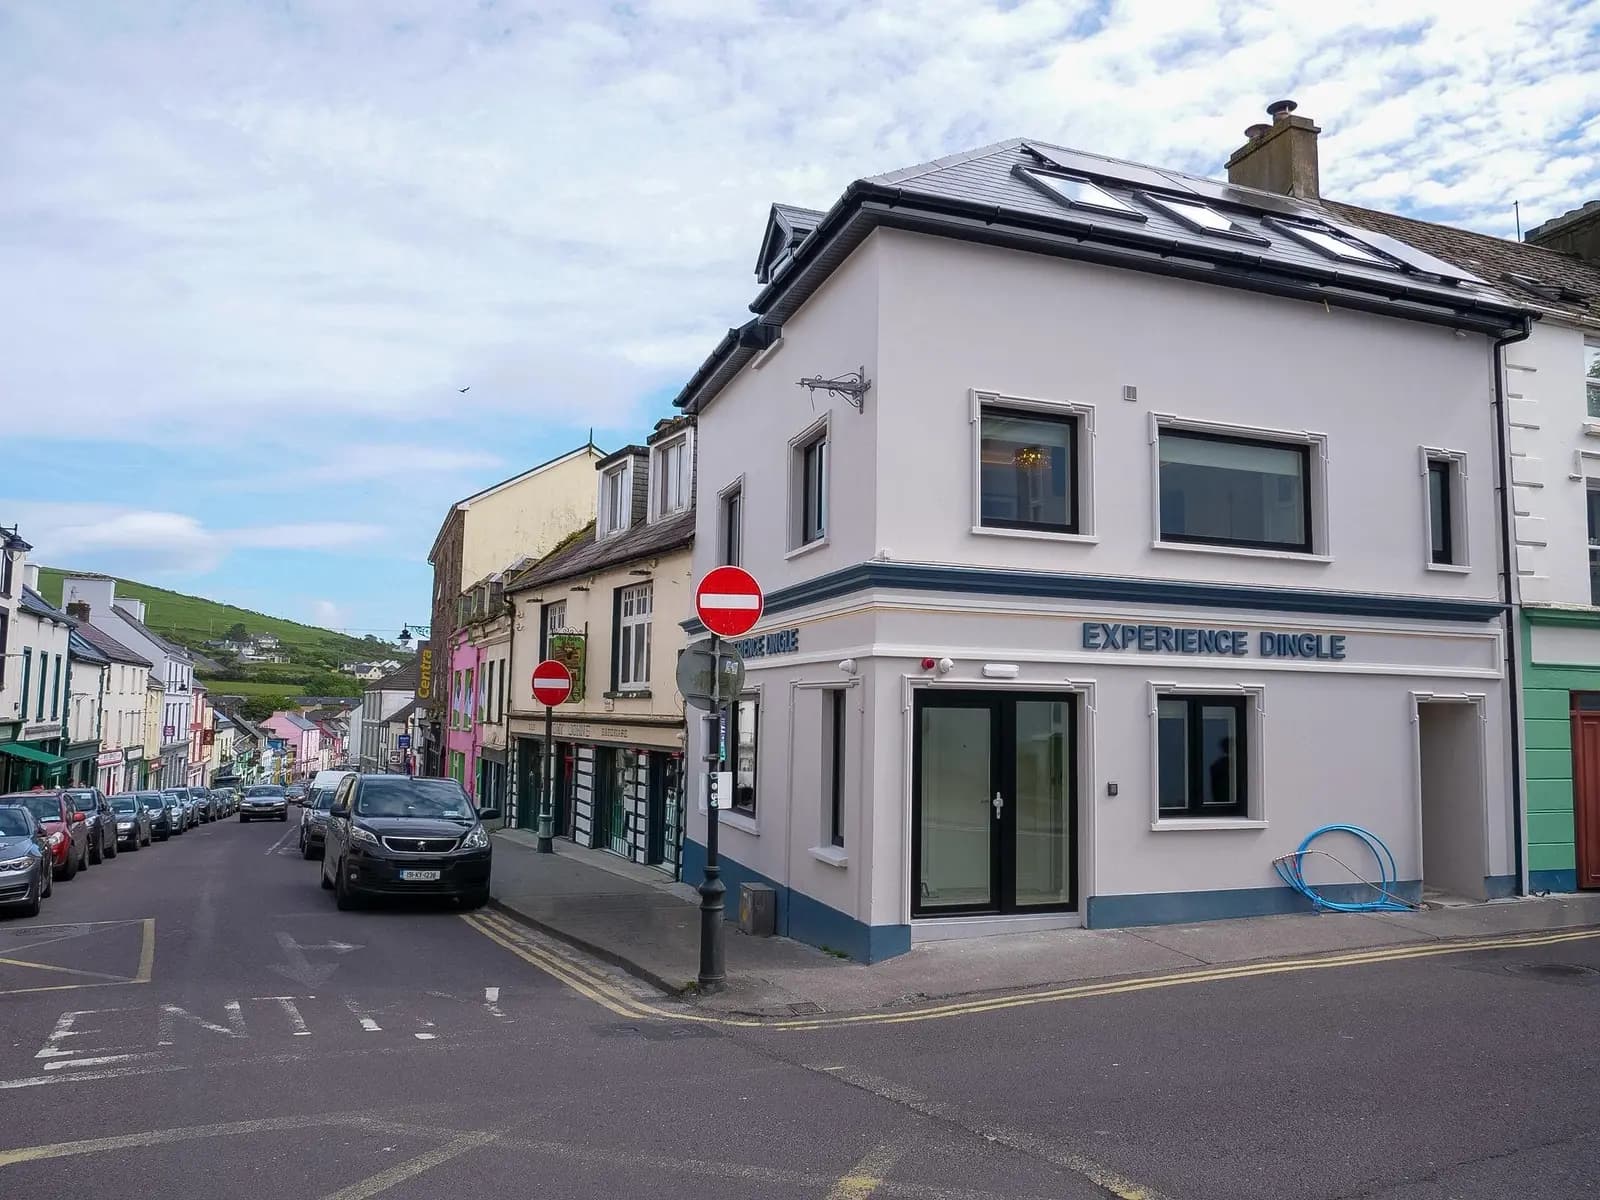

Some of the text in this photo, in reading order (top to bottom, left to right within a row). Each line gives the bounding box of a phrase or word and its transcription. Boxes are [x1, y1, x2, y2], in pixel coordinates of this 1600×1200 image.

[766, 628, 799, 655] DINGLE
[1082, 622, 1346, 659] EXPERIENCE DINGLE
[417, 648, 433, 699] Centra
